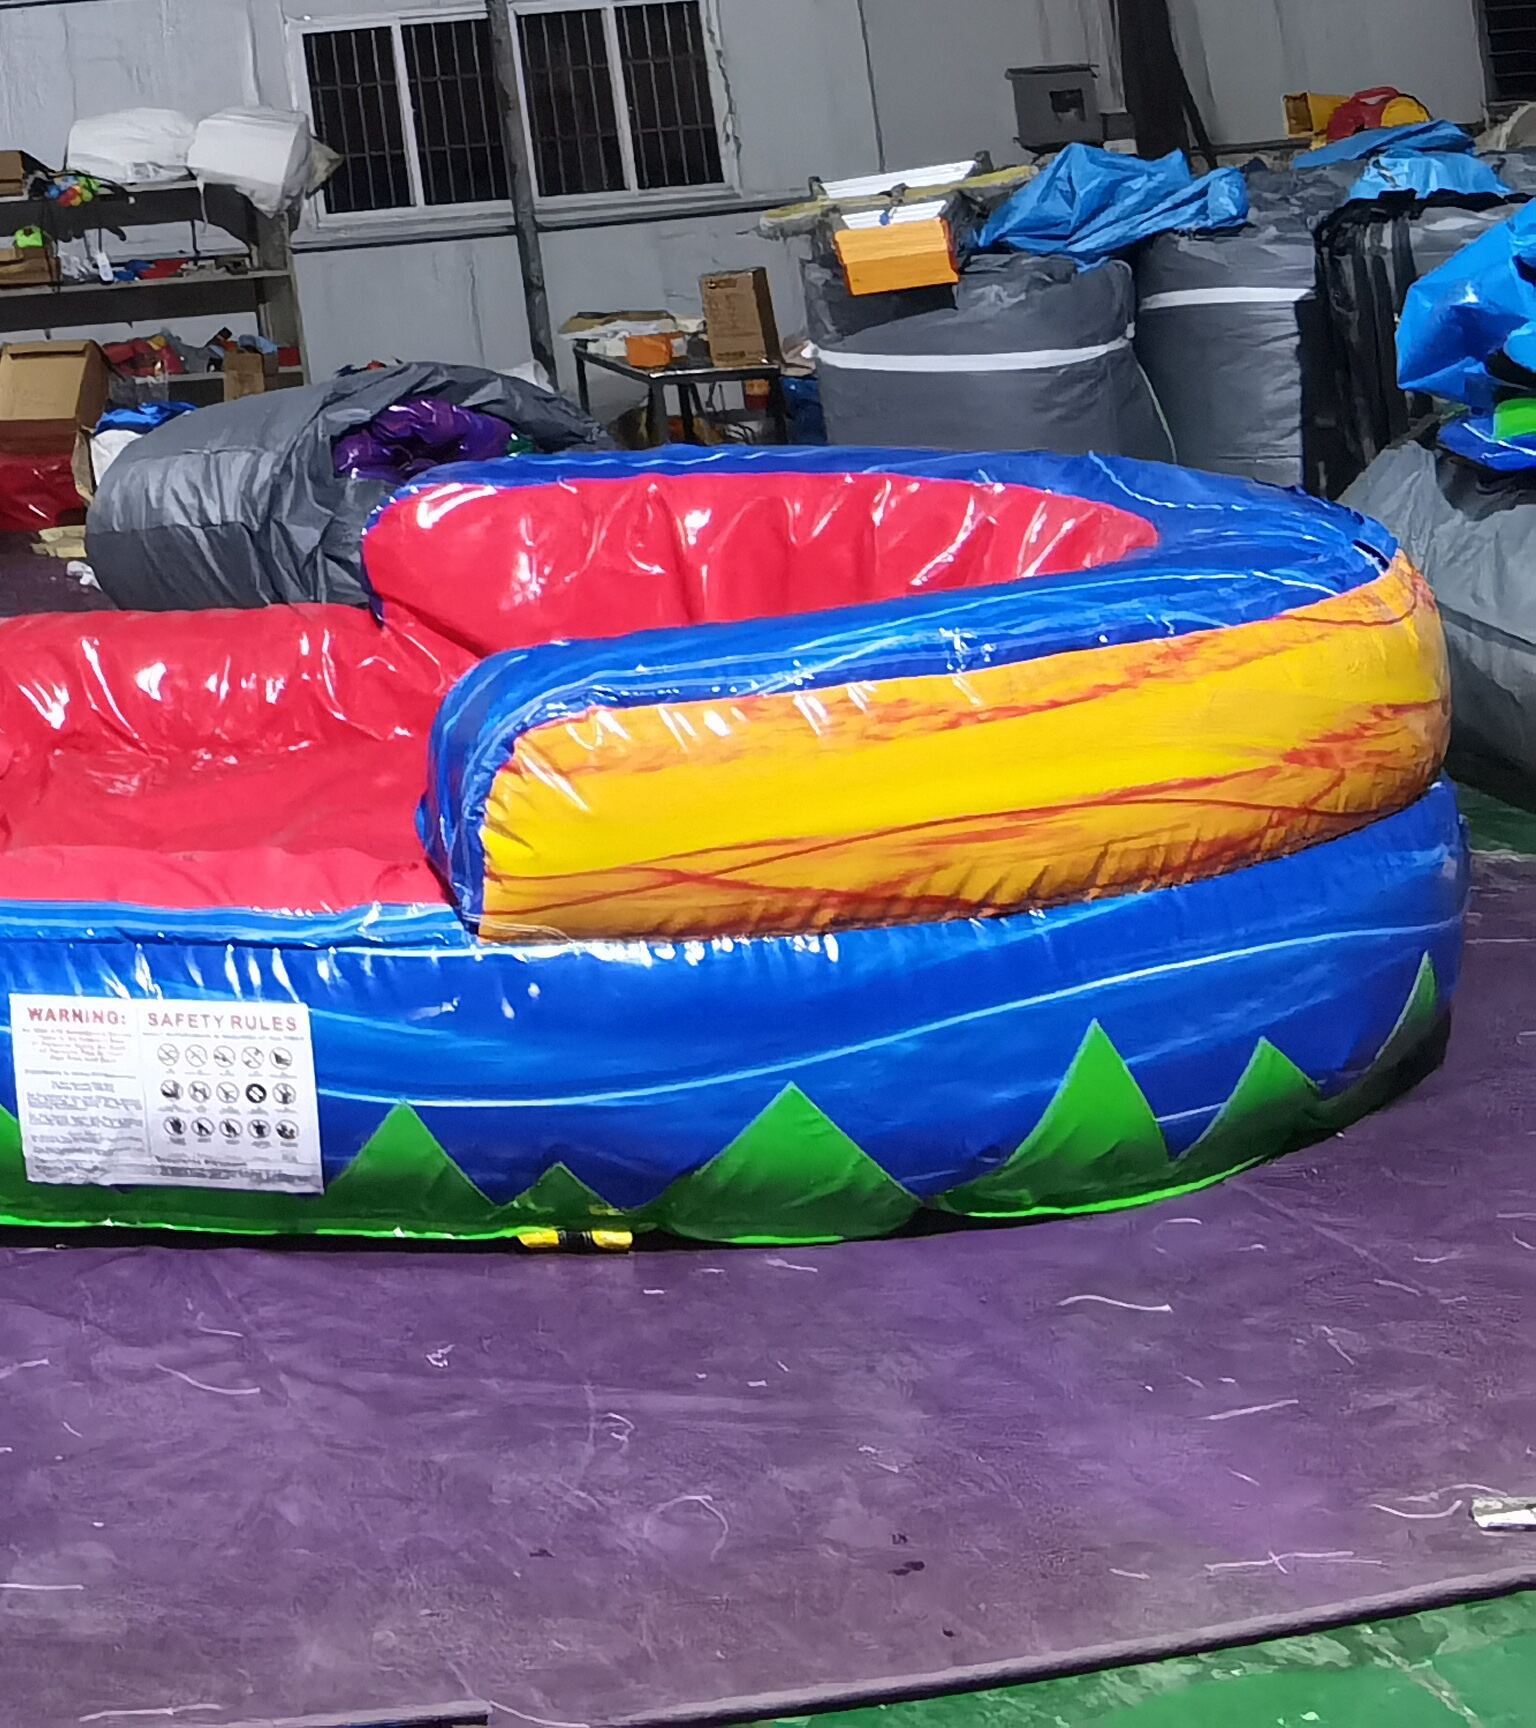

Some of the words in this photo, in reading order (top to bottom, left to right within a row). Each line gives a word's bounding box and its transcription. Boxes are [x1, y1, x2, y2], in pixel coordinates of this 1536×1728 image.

[27, 1007, 126, 1025] WARNING:
[148, 1012, 223, 1029] SAFETY
[231, 1015, 298, 1032] RULES
